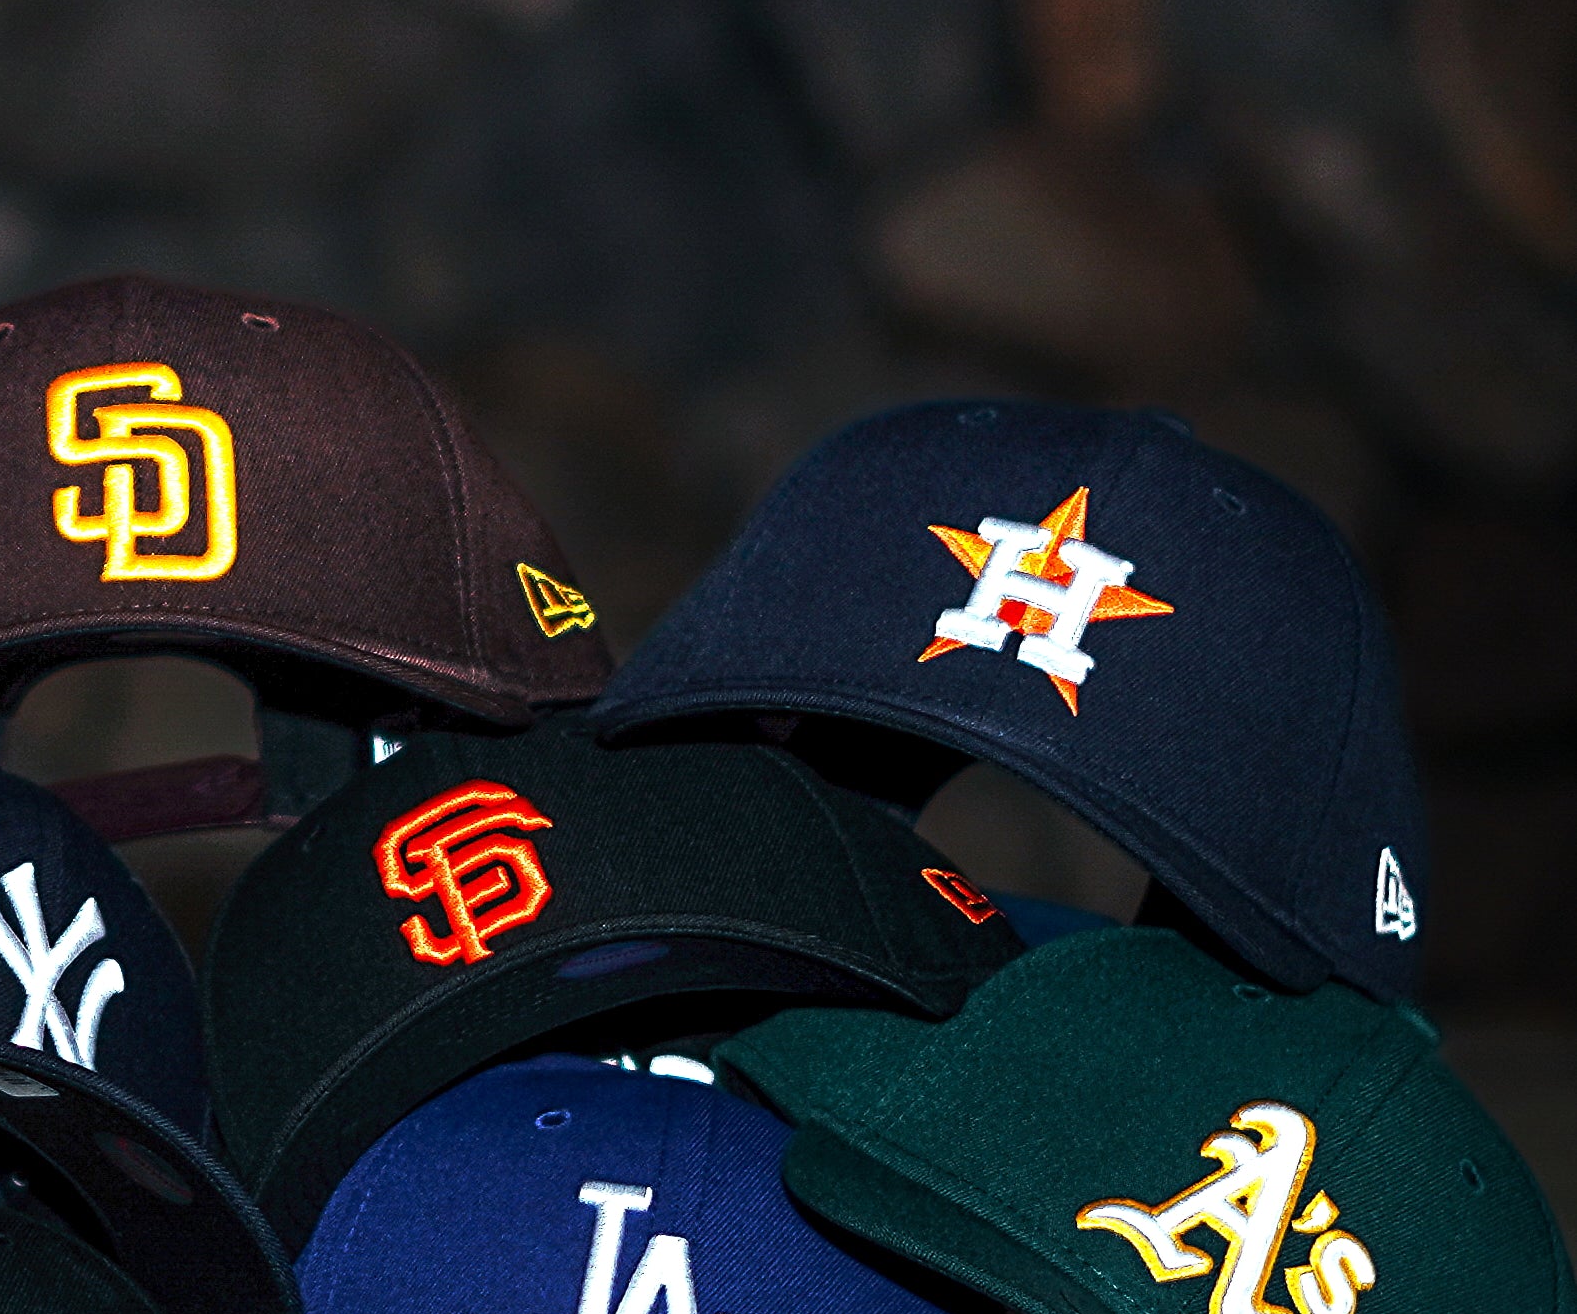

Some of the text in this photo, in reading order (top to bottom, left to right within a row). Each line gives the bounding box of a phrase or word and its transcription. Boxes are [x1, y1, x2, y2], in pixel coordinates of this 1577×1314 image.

[45, 360, 238, 583] SD
[935, 518, 1135, 685] H
[373, 781, 553, 966] SF
